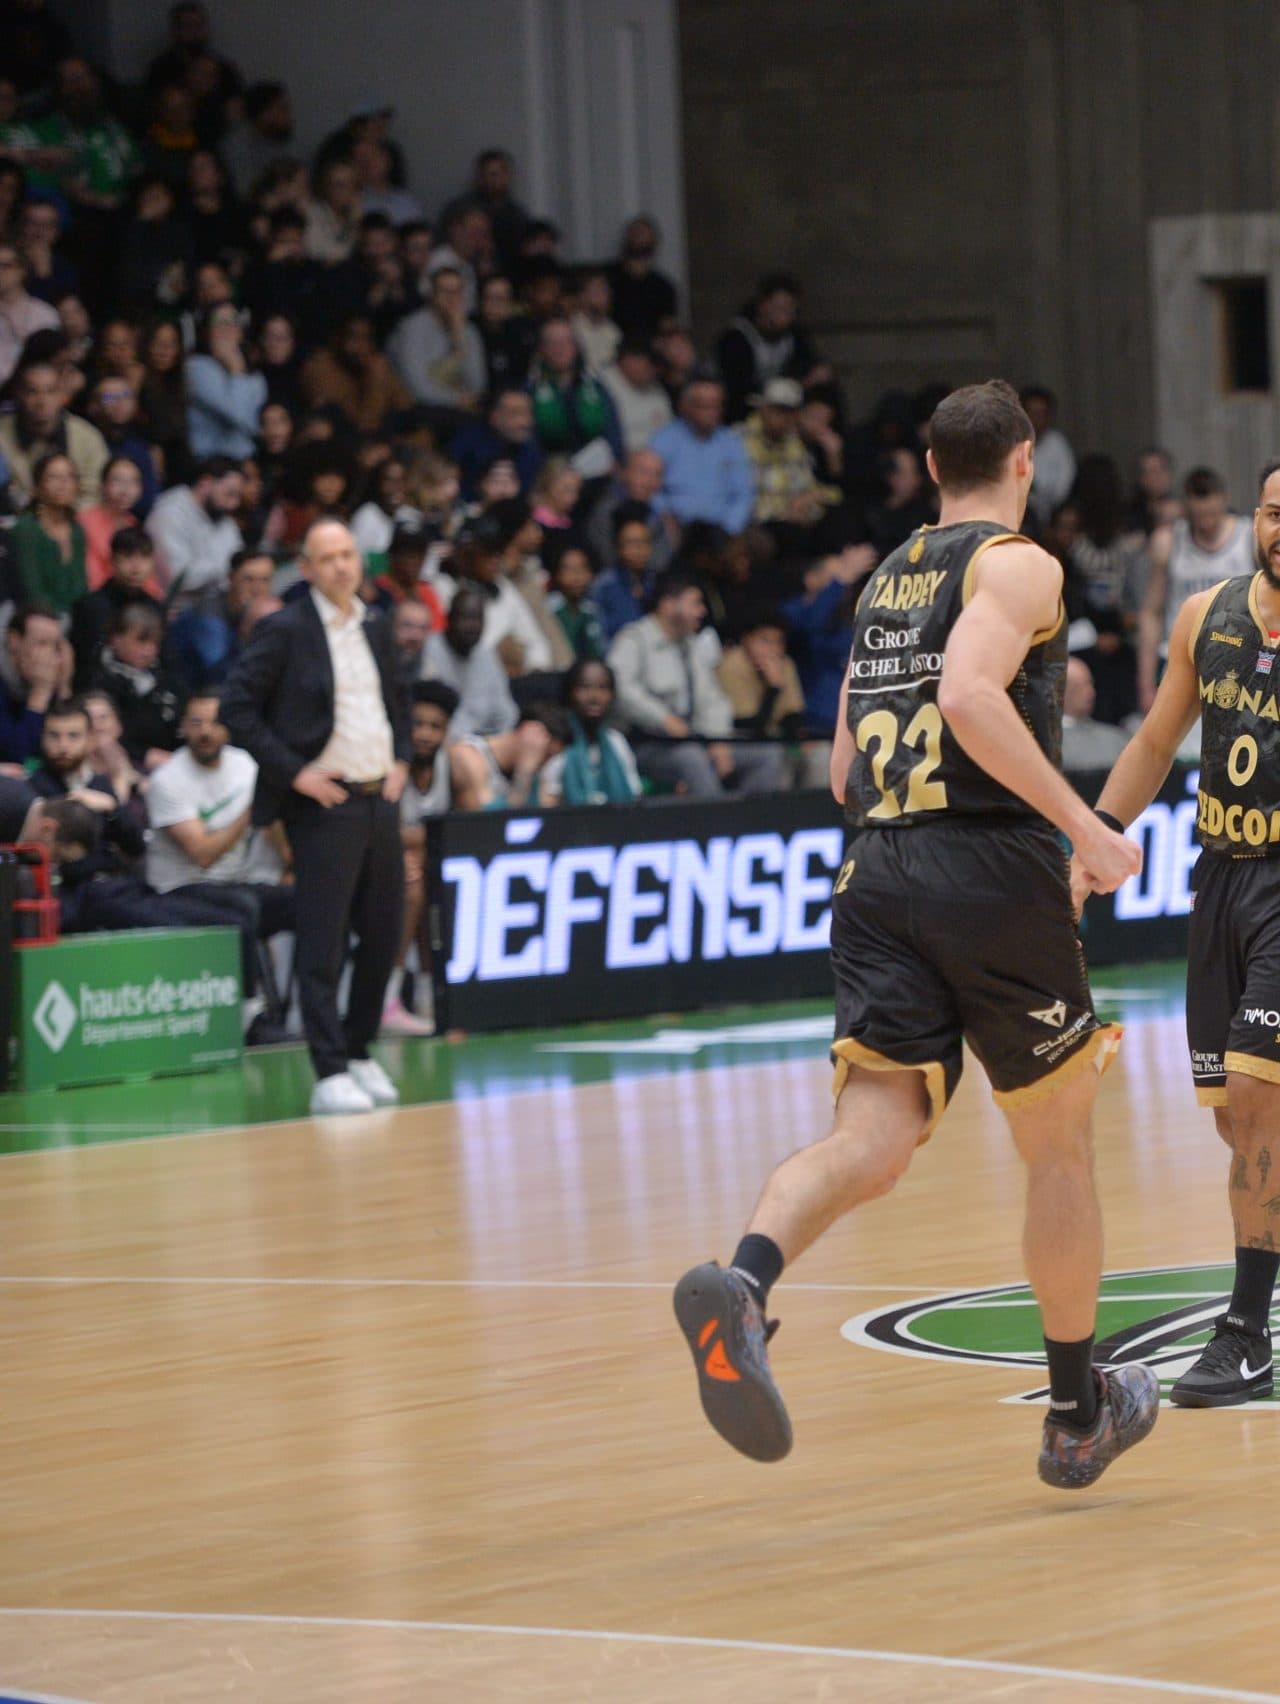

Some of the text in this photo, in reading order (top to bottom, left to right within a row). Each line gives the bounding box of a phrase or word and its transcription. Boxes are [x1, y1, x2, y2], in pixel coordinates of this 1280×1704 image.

[869, 570, 948, 611] TARPEY
[849, 653, 945, 678] ICHEL ASTO
[857, 703, 948, 819] 22
[1227, 734, 1258, 787] 0
[441, 817, 845, 984] DÉFENSE
[1032, 1012, 1092, 1057] CUPRA
